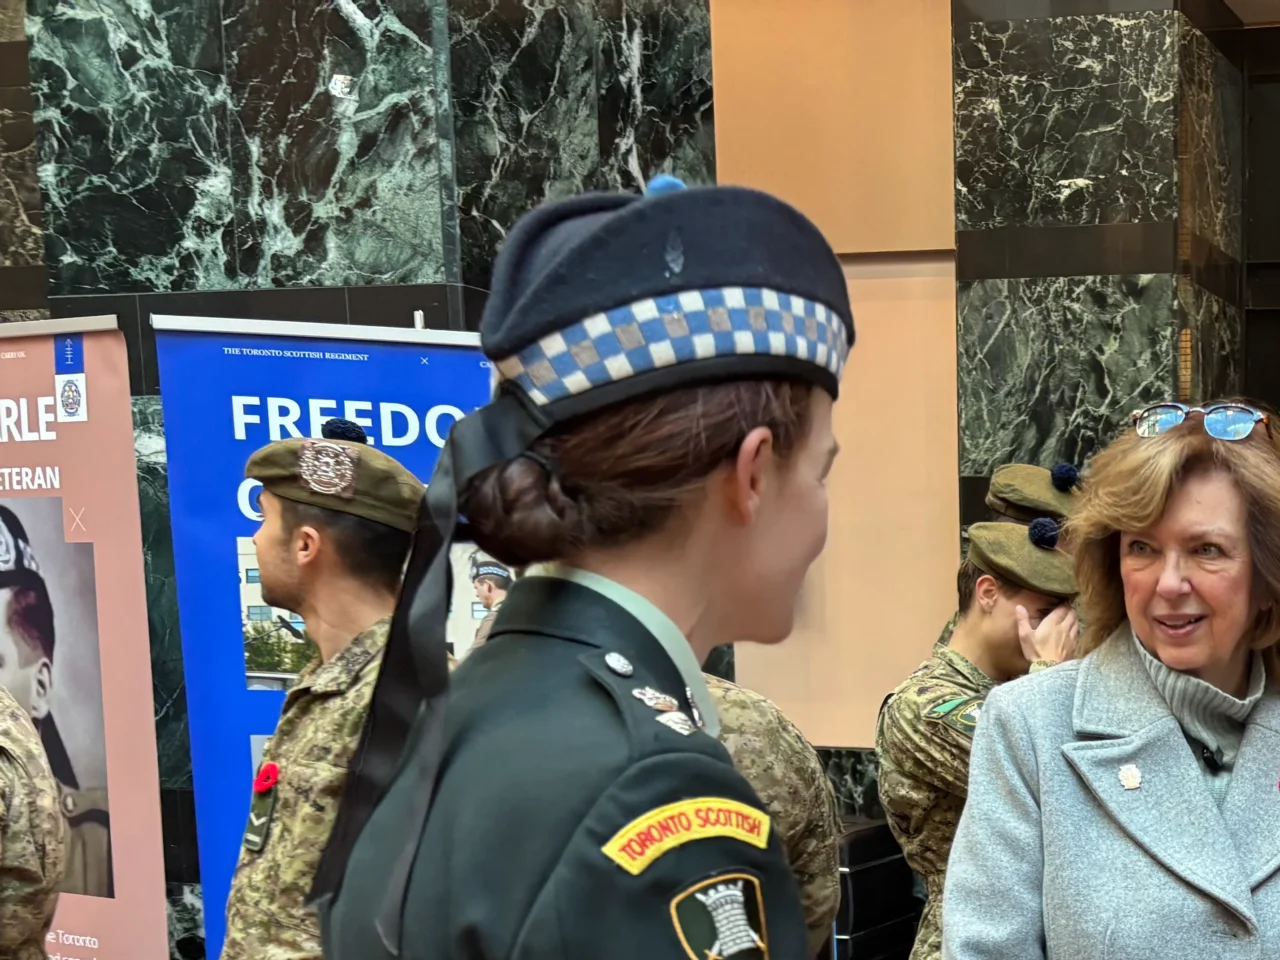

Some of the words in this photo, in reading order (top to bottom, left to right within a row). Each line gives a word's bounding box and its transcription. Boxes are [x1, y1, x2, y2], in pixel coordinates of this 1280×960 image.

[222, 347, 241, 355] THE
[242, 348, 282, 357] TORONTO
[283, 350, 323, 359] SCOTTISH
[325, 352, 369, 361] REGIMENT
[0, 396, 57, 442] RLE
[231, 395, 477, 449] FREEDO
[0, 466, 60, 490] TERAN
[618, 812, 692, 861] TORONTO
[694, 807, 762, 838] SCOTTISH
[56, 929, 99, 949] Toronto
